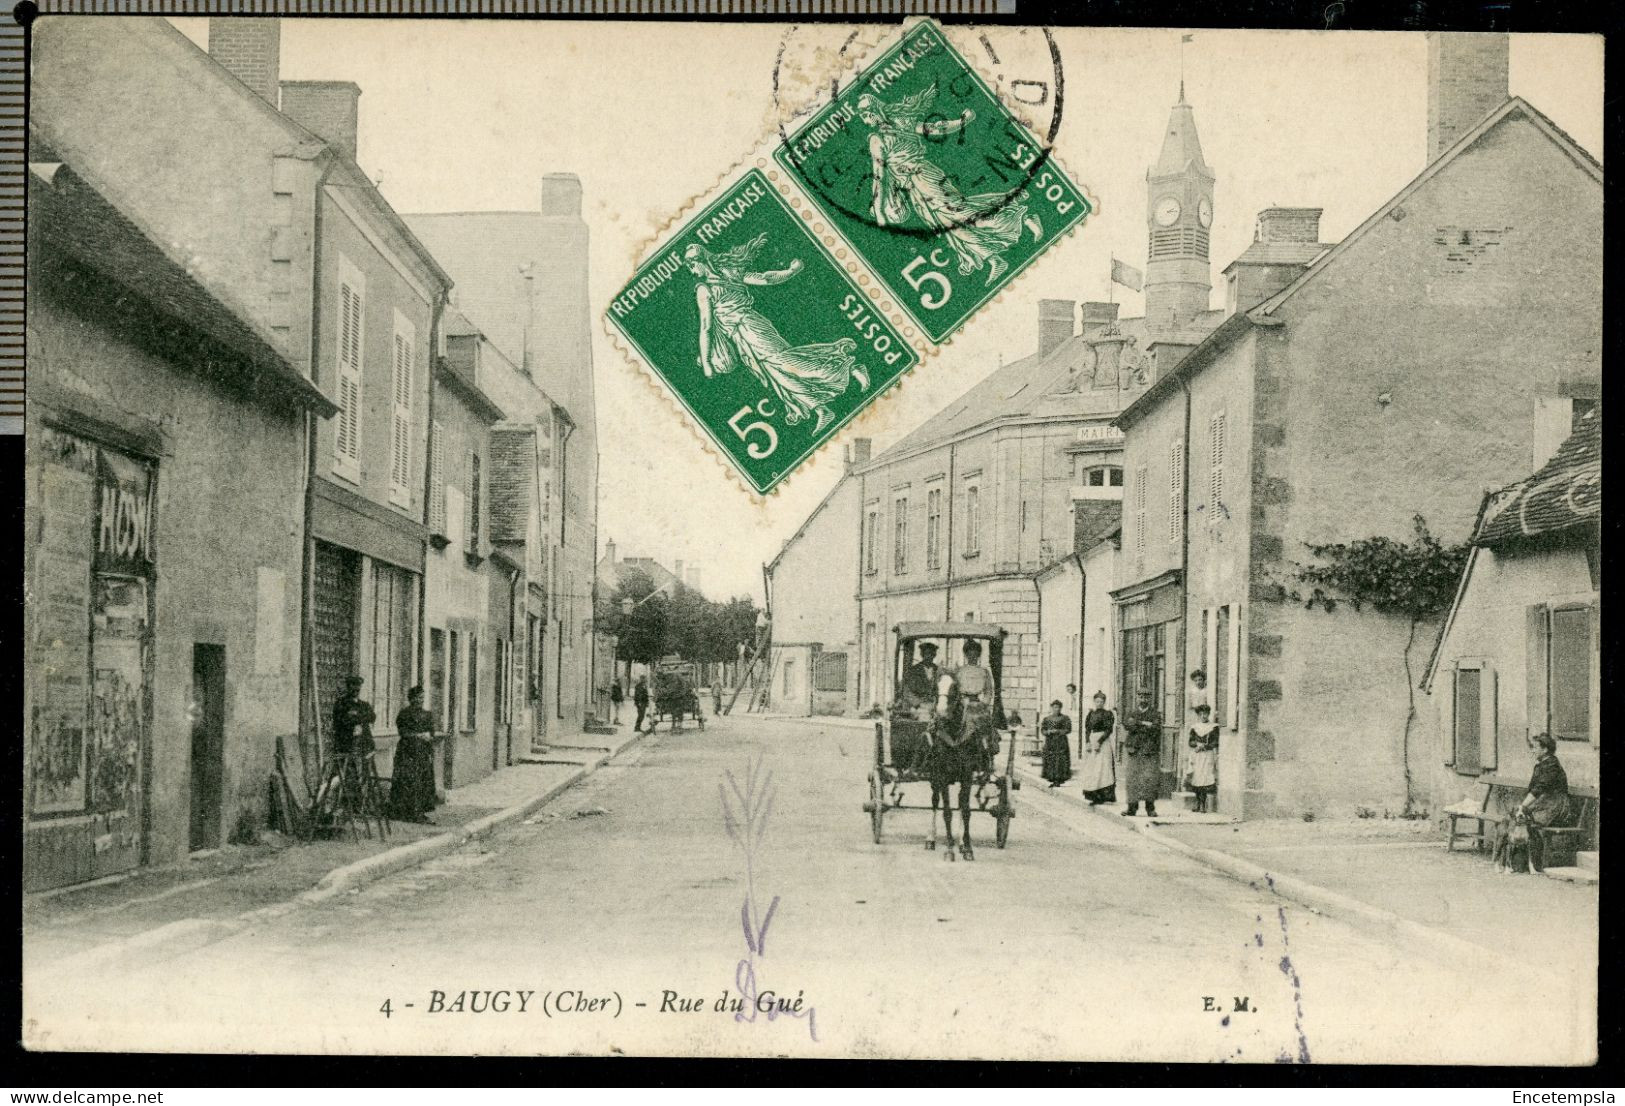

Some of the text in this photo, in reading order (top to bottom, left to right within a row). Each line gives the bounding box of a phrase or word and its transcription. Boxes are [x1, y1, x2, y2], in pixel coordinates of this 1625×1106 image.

[696, 181, 766, 244] FRANÇAISE
[1010, 143, 1075, 215] POSES
[838, 293, 903, 365] POSTES
